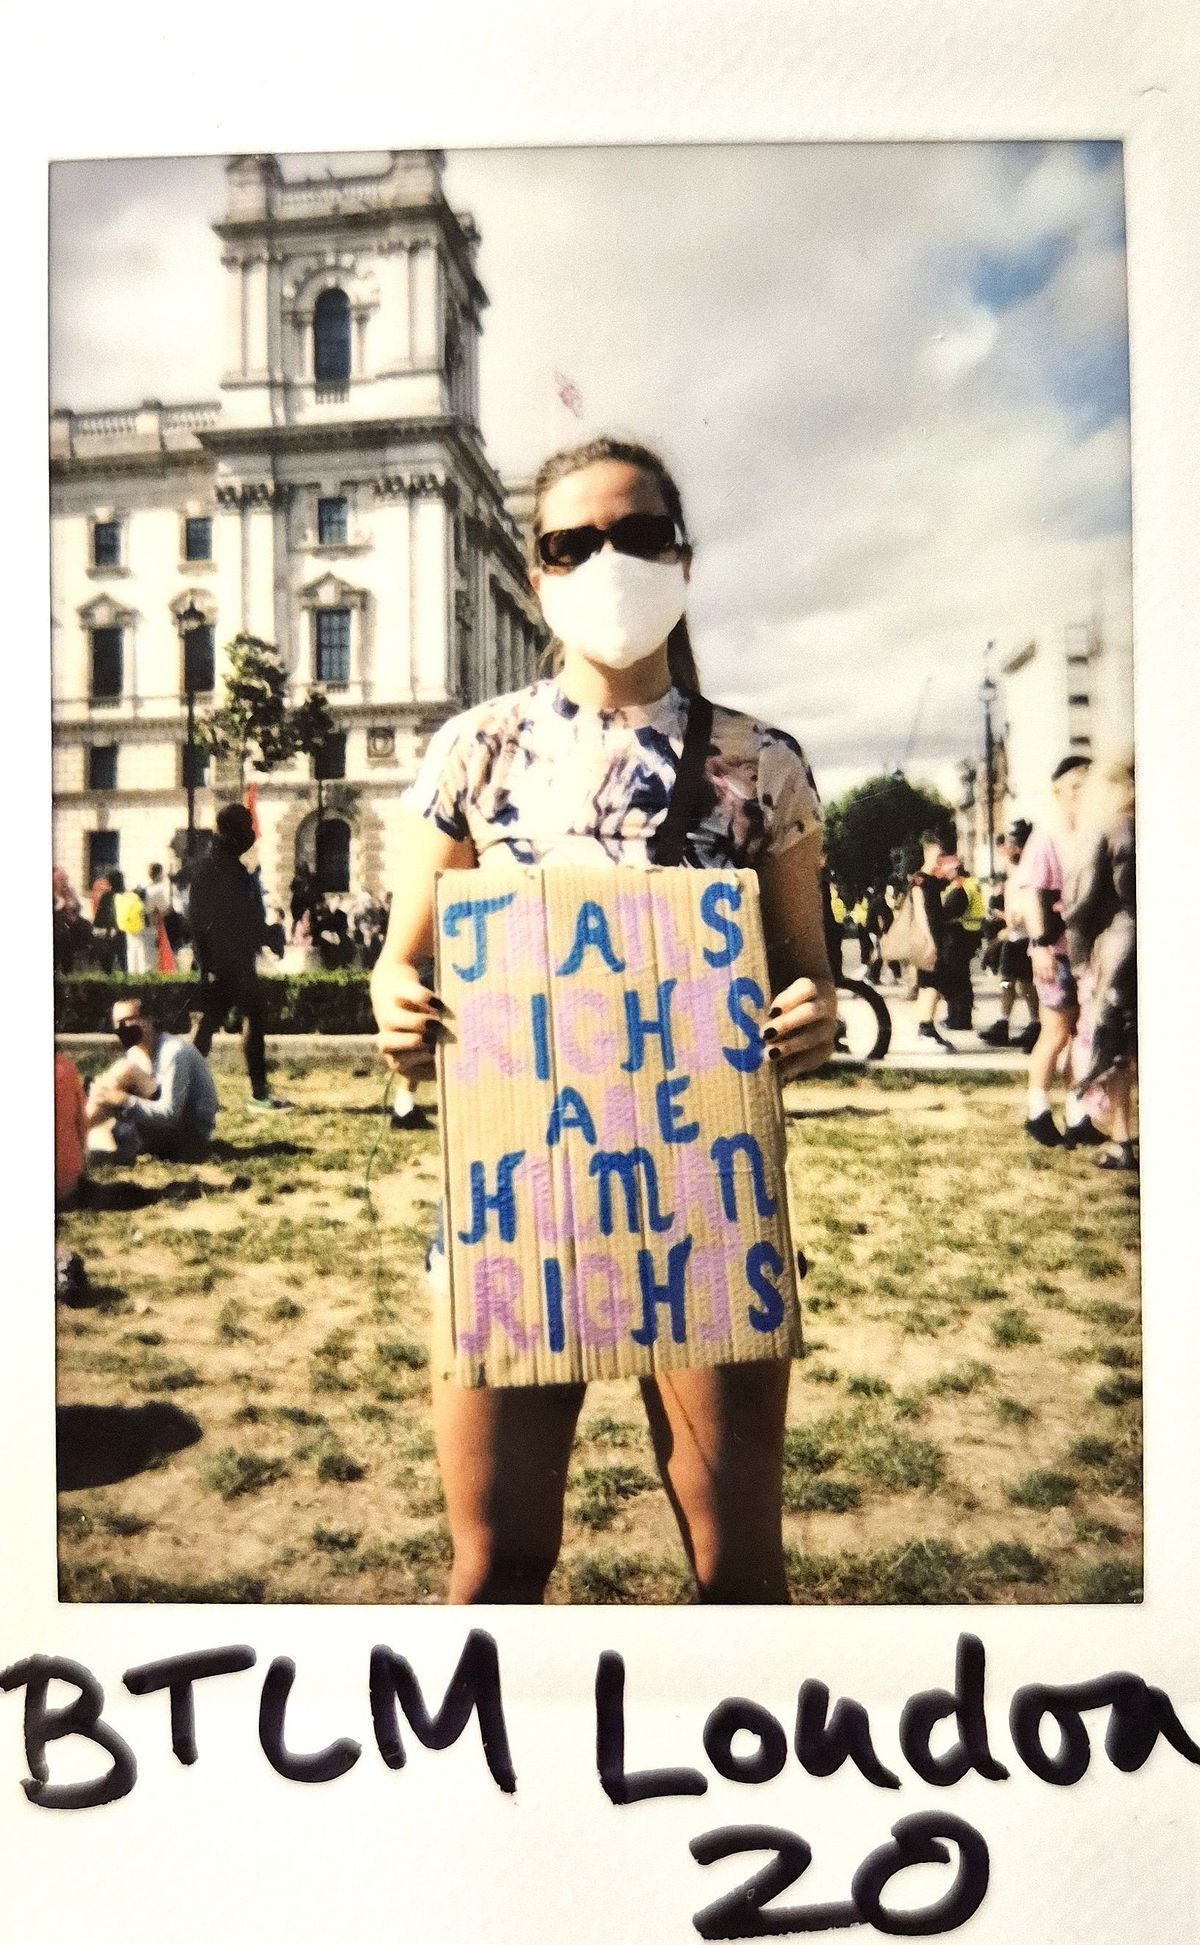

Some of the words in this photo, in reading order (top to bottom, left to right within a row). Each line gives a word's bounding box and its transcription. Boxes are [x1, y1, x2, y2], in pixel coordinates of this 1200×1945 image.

[455, 976, 765, 1086] RIGHTS
[546, 1075, 701, 1149] ARE
[459, 1234, 787, 1354] RIGHTS
[596, 1634, 1200, 1805] London
[689, 1812, 990, 1940] 20
